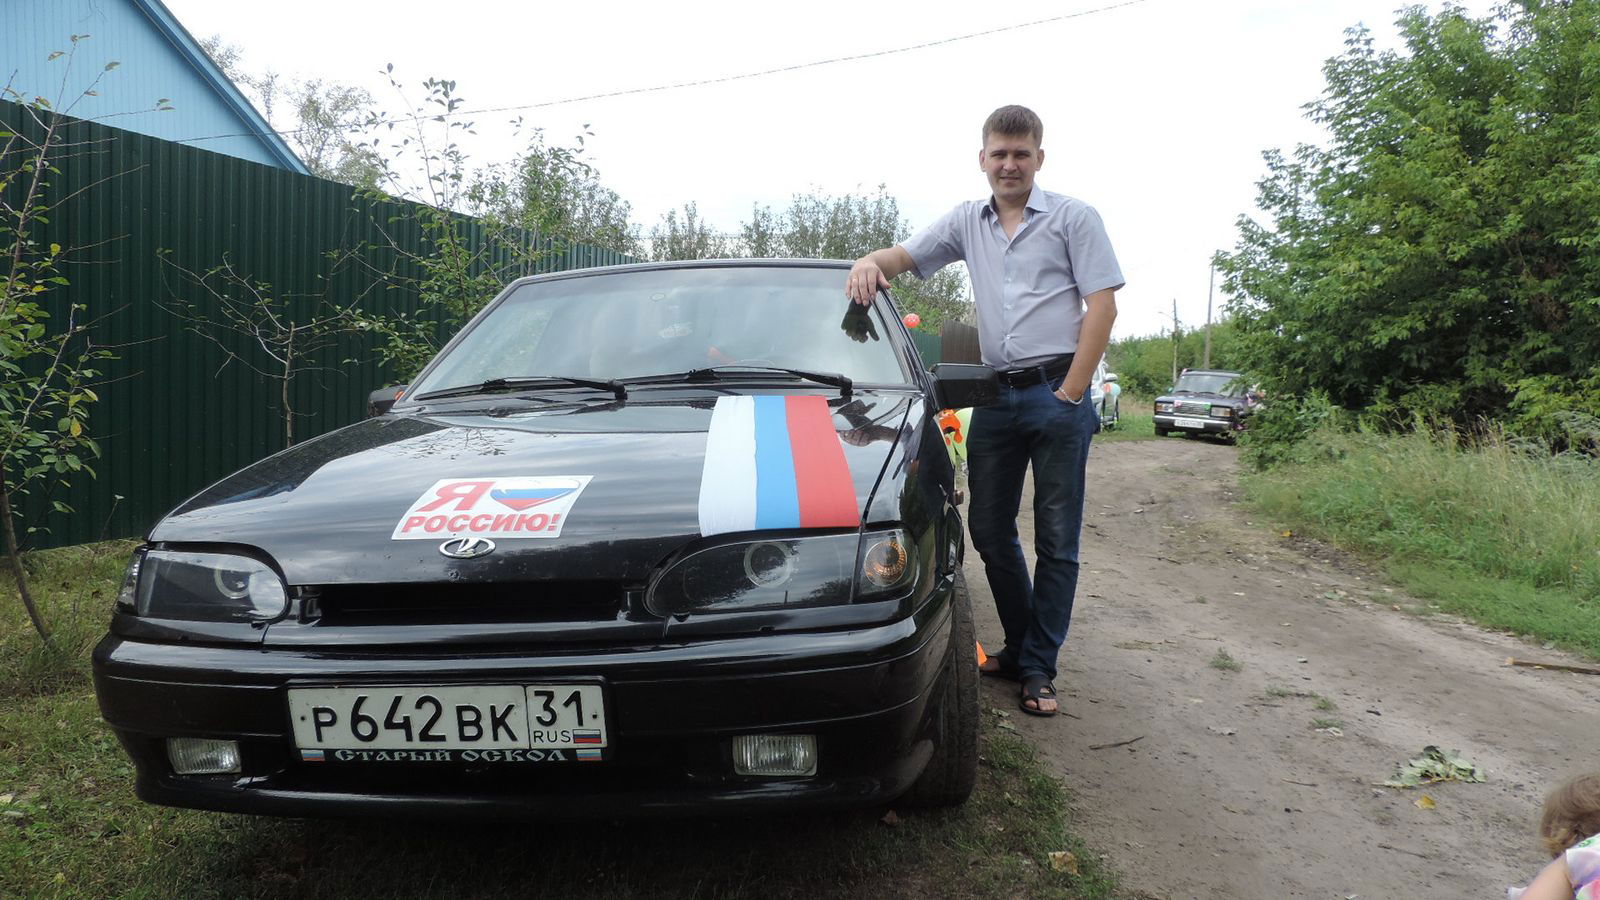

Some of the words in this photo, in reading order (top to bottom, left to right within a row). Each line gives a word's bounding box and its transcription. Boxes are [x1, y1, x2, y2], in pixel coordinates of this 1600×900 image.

[415, 481, 495, 512] Я
[401, 513, 560, 533] РОССИЮ!
[533, 690, 584, 727] 31
[532, 730, 571, 743] RUS
